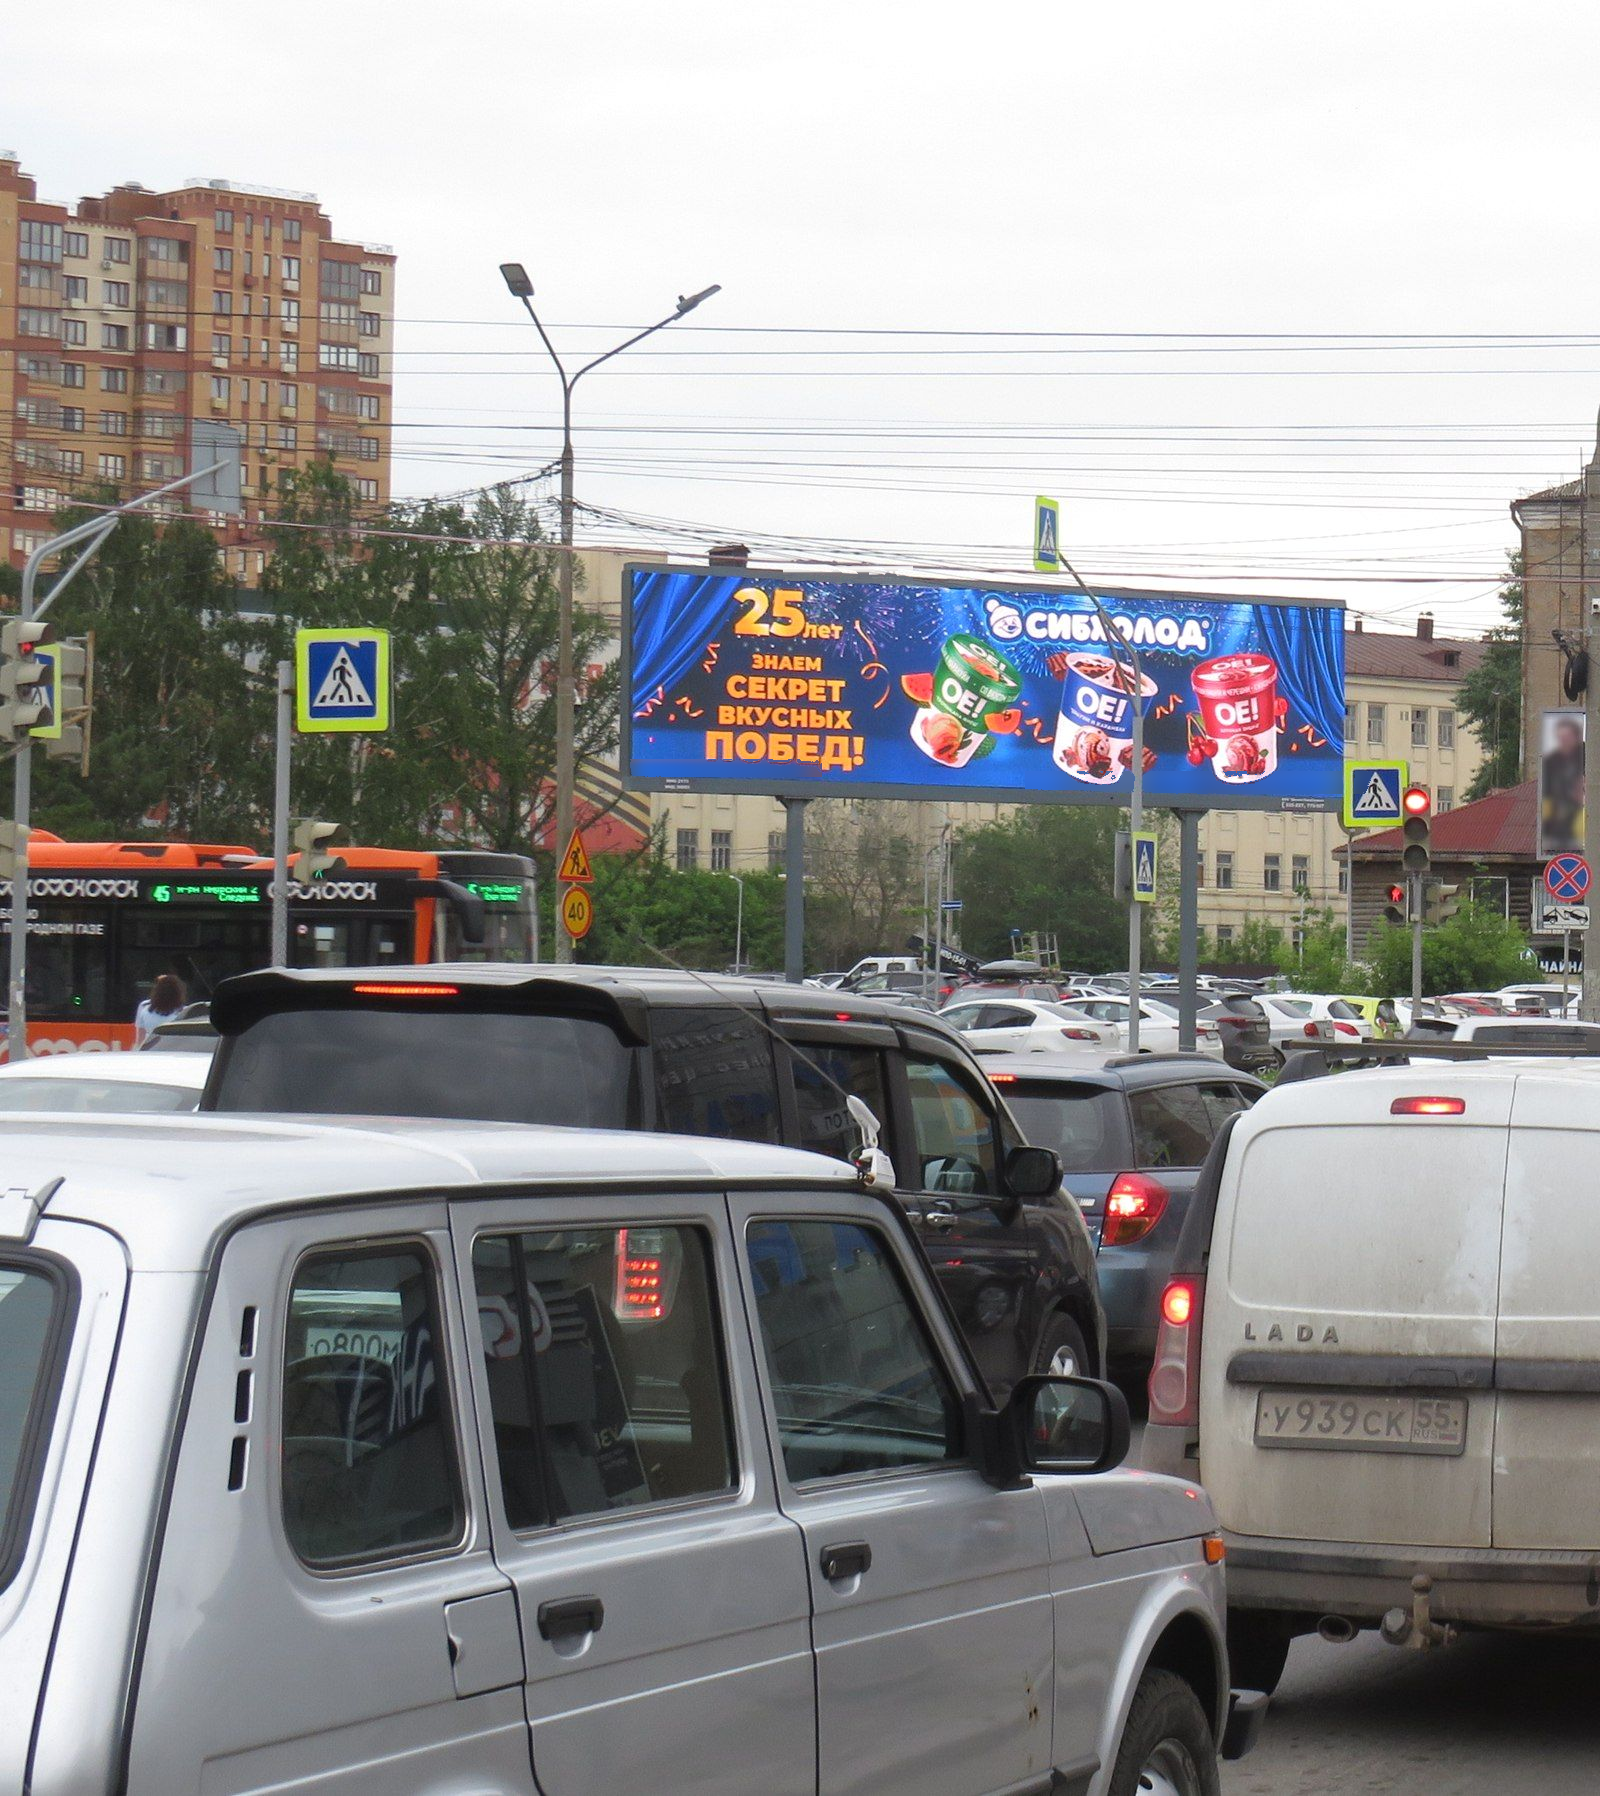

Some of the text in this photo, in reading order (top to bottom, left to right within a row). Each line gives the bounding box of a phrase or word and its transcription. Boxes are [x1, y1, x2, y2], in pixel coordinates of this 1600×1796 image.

[734, 588, 843, 640] 25 лет
[752, 654, 822, 672] ЗНАЕМ
[726, 675, 846, 703] СЕКРЕТ
[941, 677, 987, 719] ОЕ!
[718, 705, 852, 729] ВКУСНЫХ
[1076, 686, 1128, 723] ОЕ!
[1214, 697, 1259, 726] ОЕ!
[705, 730, 864, 771] ПОБЕД!
[568, 902, 585, 921] 40
[1244, 1322, 1340, 1344] LADA
[1274, 1398, 1451, 1437] У939СК 55
